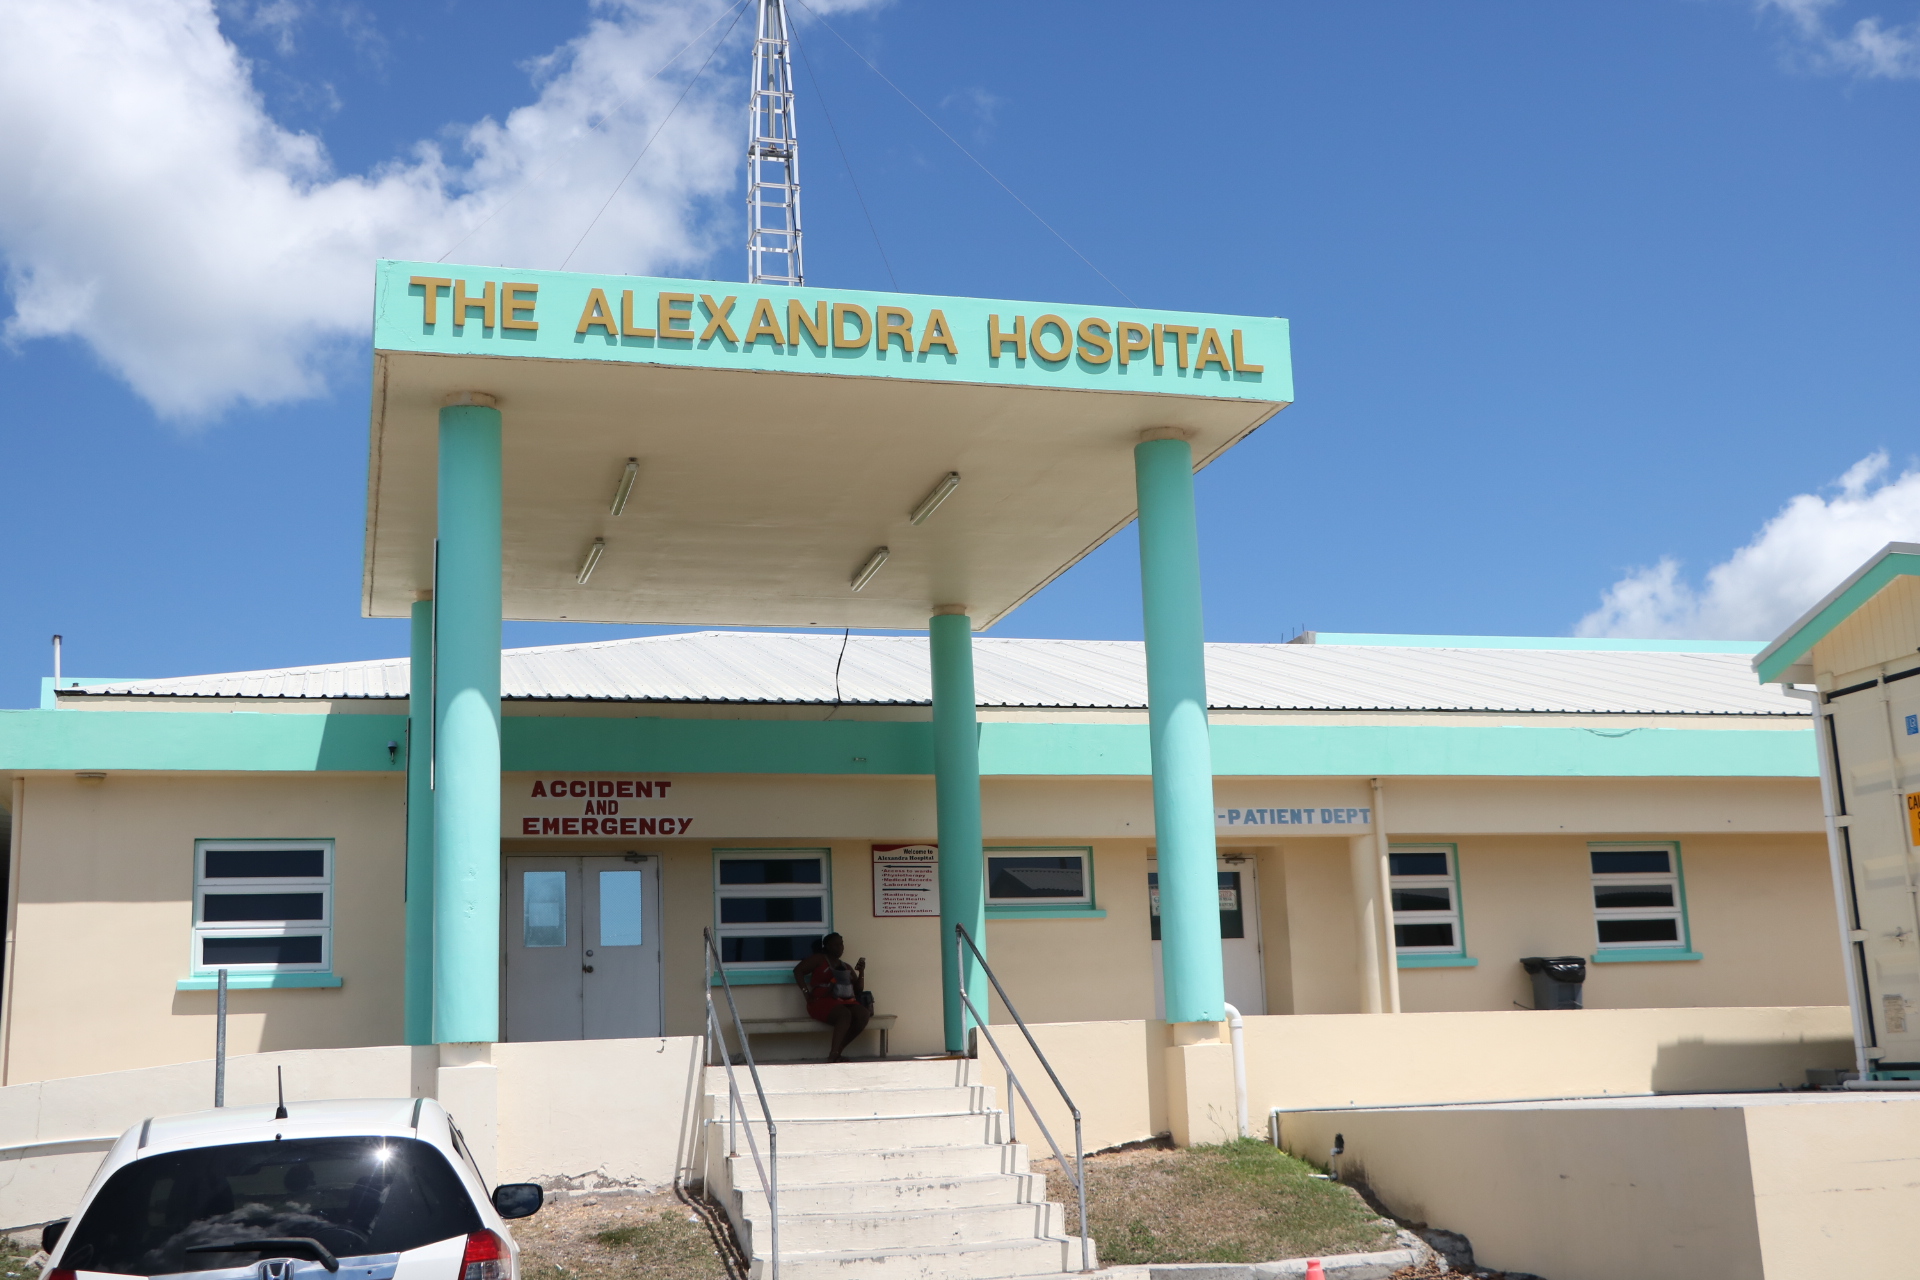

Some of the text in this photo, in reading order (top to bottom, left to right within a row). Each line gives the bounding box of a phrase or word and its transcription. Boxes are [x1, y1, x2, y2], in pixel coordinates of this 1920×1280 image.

[409, 276, 1264, 373] THE ALEXANDRA HOSPITAL
[531, 780, 671, 798] ACCIDENT
[584, 800, 618, 815] AND
[1320, 808, 1370, 824] DEPT
[522, 817, 693, 835] EMERGENCY
